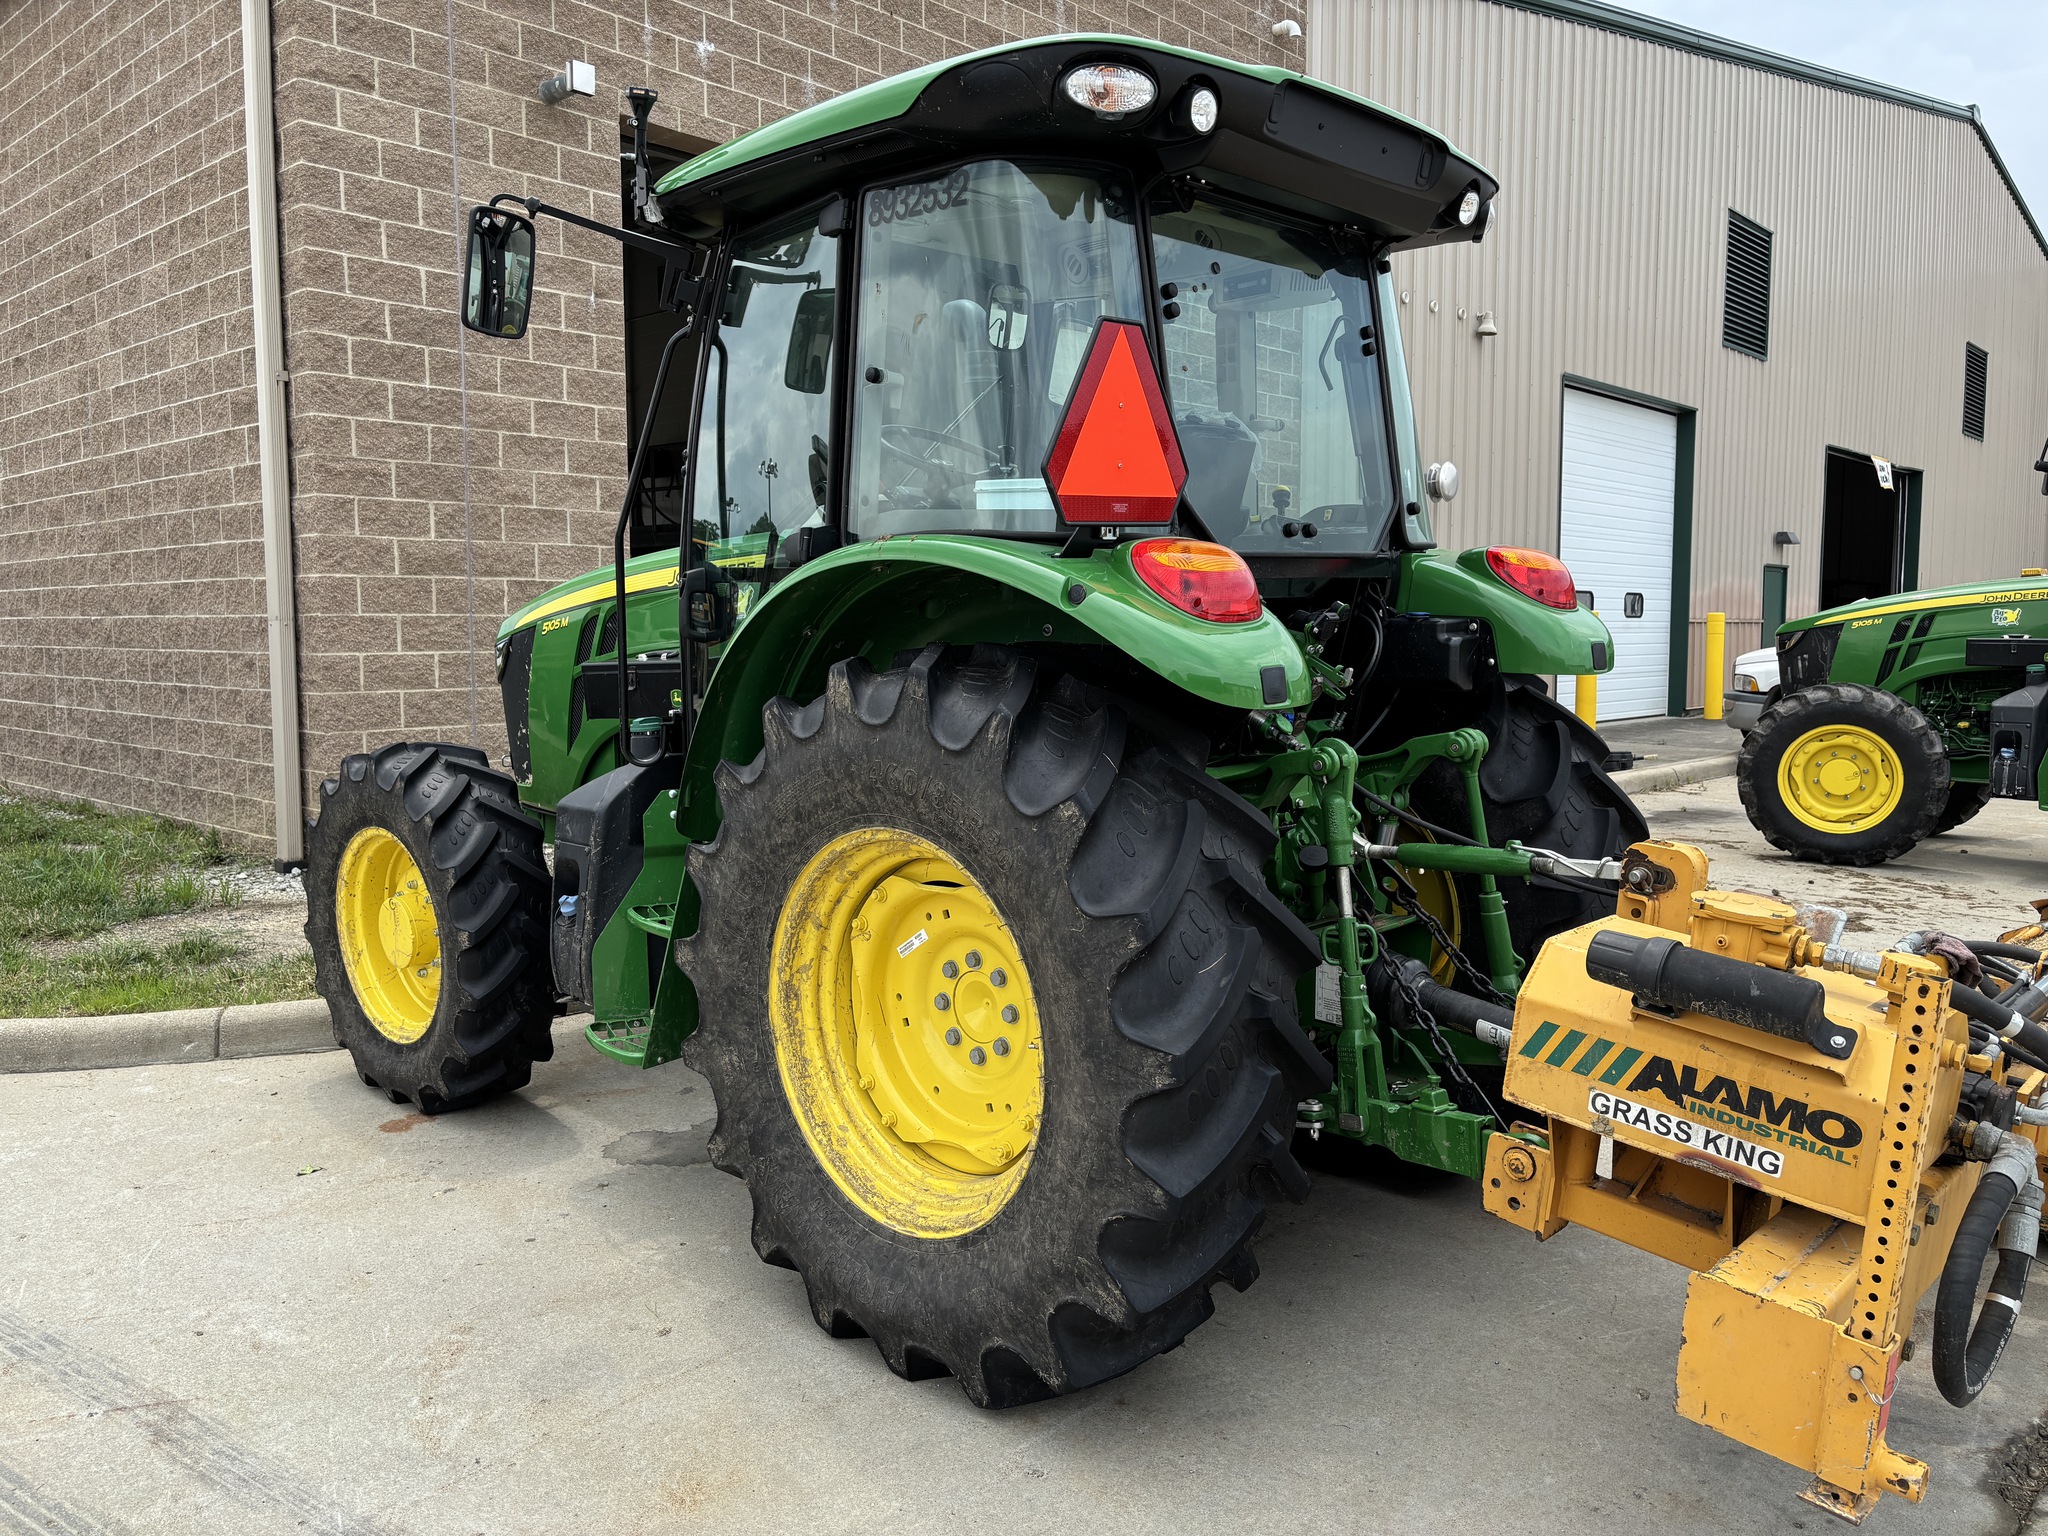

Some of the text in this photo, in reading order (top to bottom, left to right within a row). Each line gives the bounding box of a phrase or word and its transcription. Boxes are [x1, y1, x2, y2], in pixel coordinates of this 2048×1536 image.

[868, 169, 970, 227] 8932532
[542, 616, 570, 635] 5105 M
[1851, 617, 1883, 629] 5105 M
[1979, 594, 2012, 603] JOHN
[1626, 1055, 1863, 1149] ALAMO
[1591, 1092, 1781, 1175] GRASS KING
[1689, 1101, 1852, 1166] INDUSTRIAL
